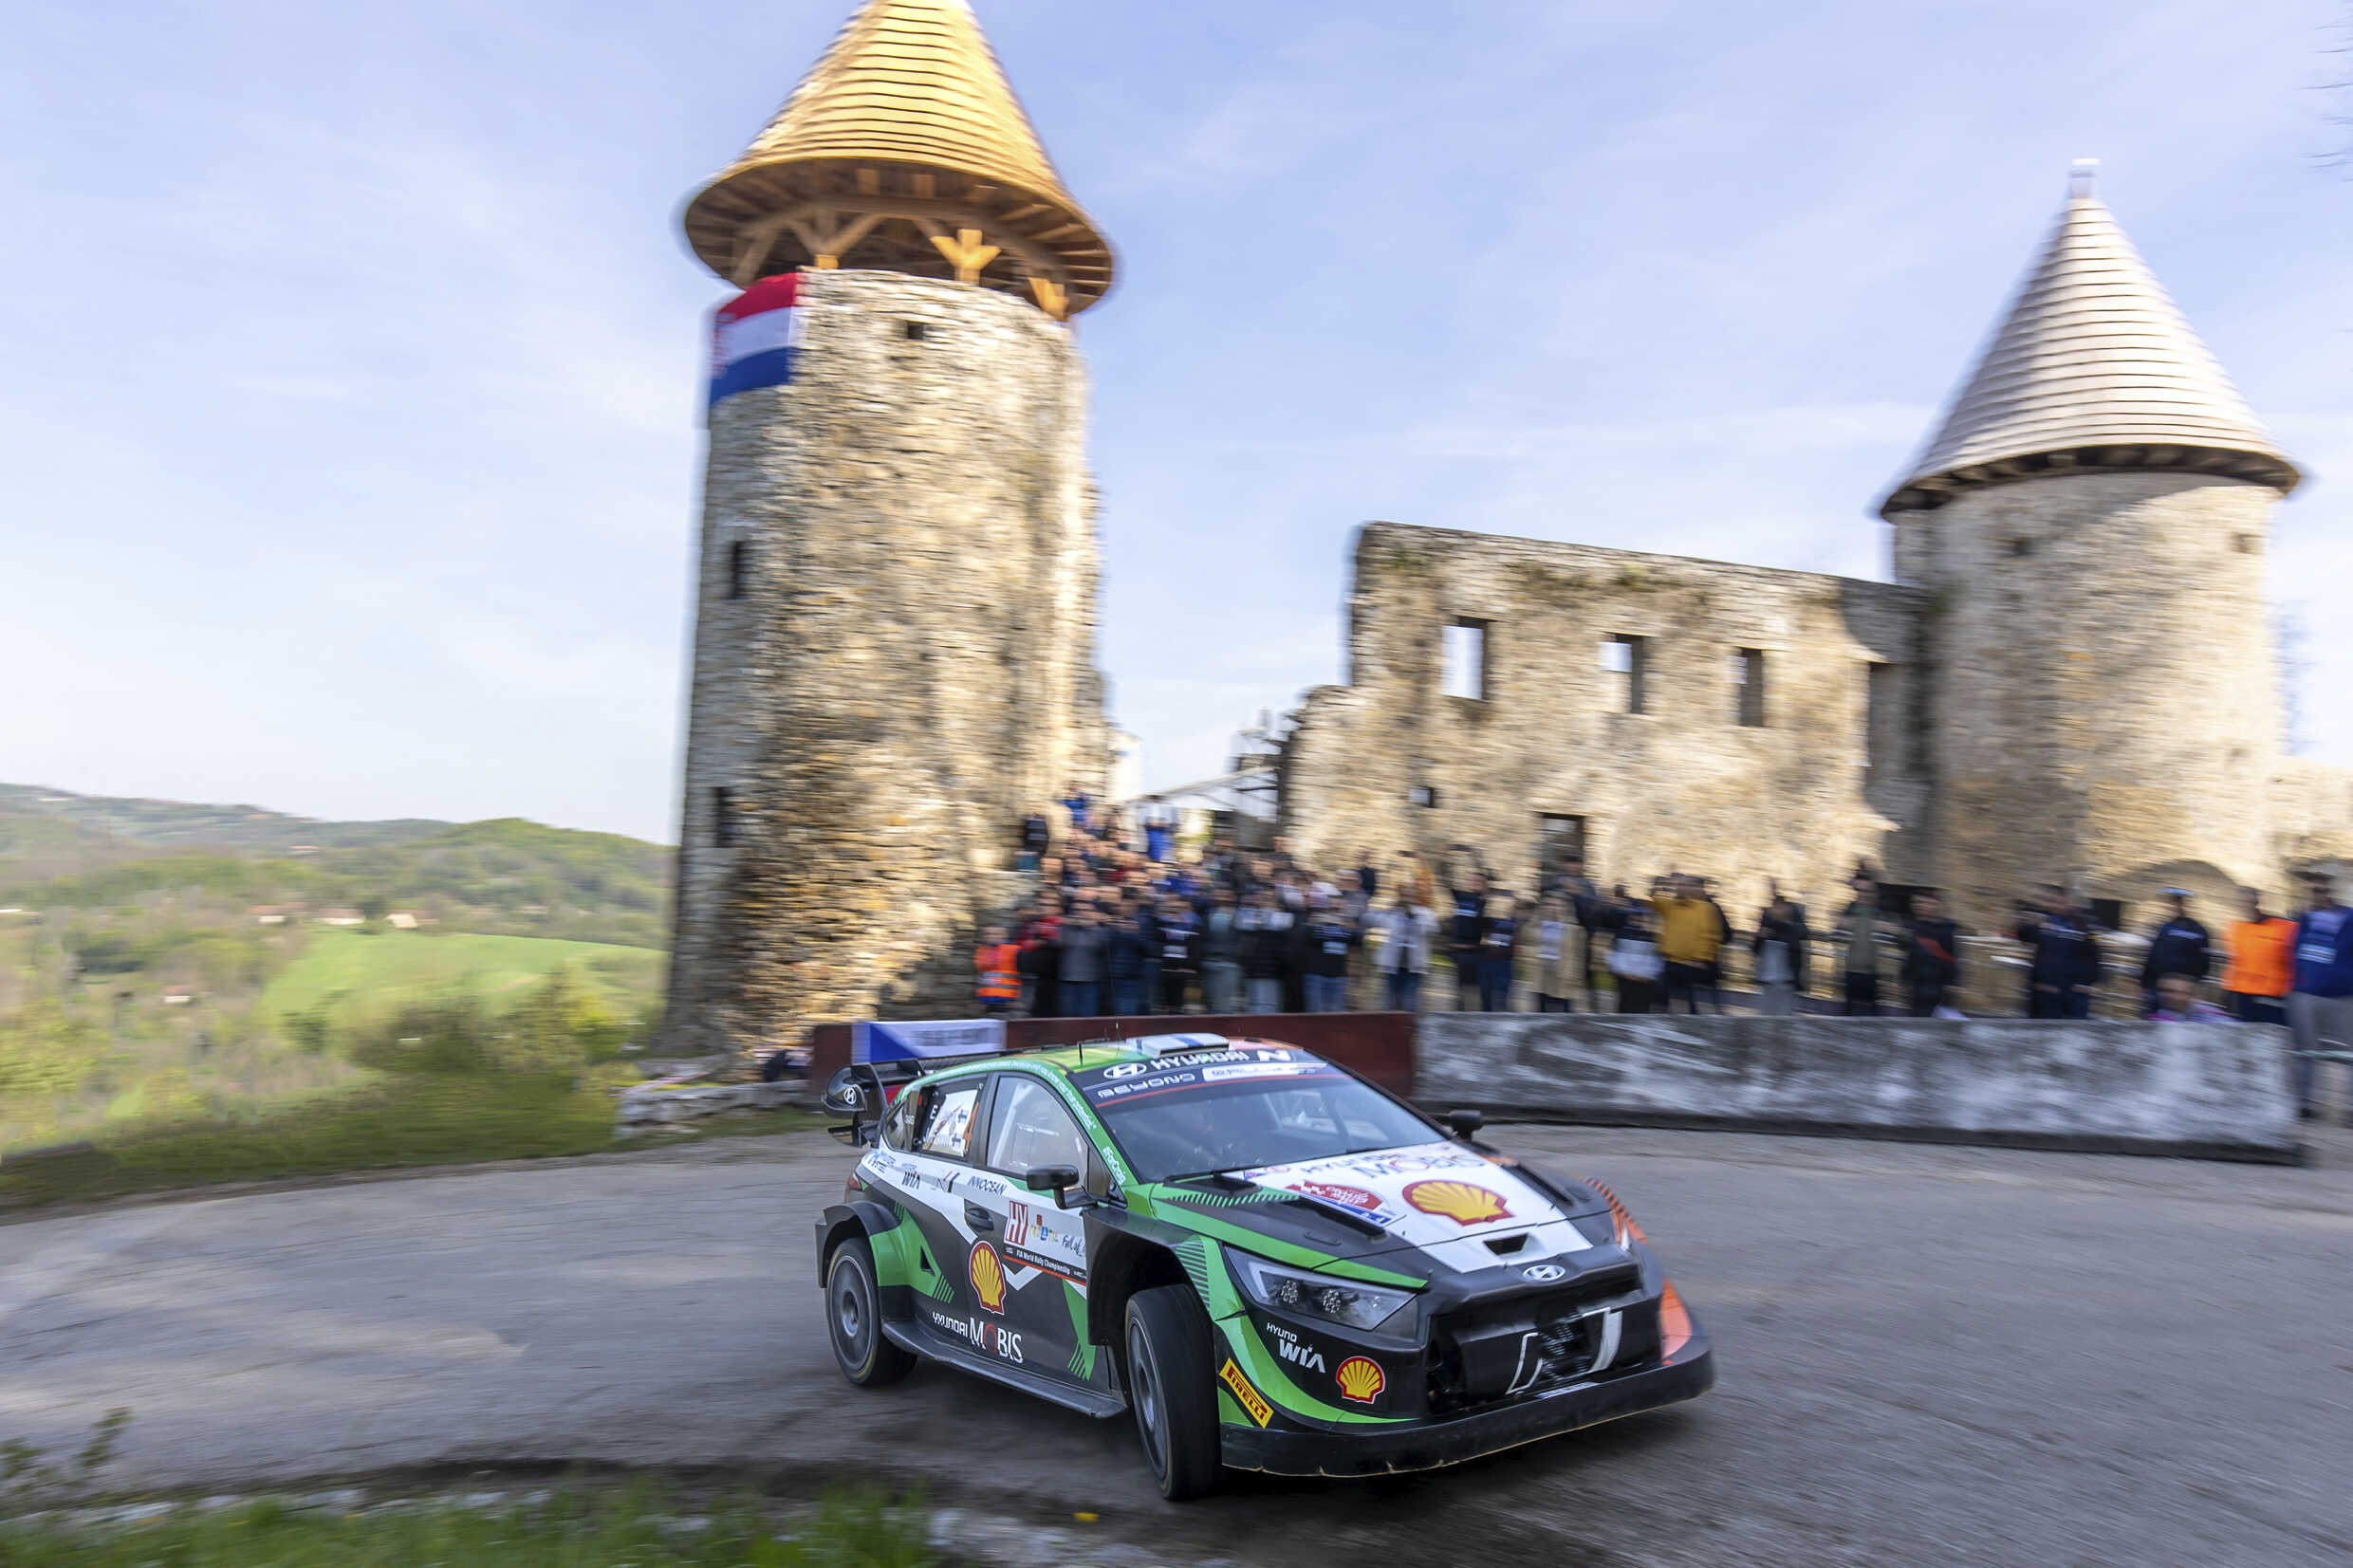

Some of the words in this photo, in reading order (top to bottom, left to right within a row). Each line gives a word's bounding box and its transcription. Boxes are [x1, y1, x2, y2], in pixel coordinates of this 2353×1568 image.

[1150, 1051, 1250, 1070] HYUNDAI
[1098, 1073, 1195, 1098] BEYOND
[968, 1175, 1007, 1196] INNOCEAN
[970, 1317, 1023, 1363] MOBIS
[1279, 1338, 1325, 1374] WIA
[1226, 1365, 1268, 1420] PIRELLI
